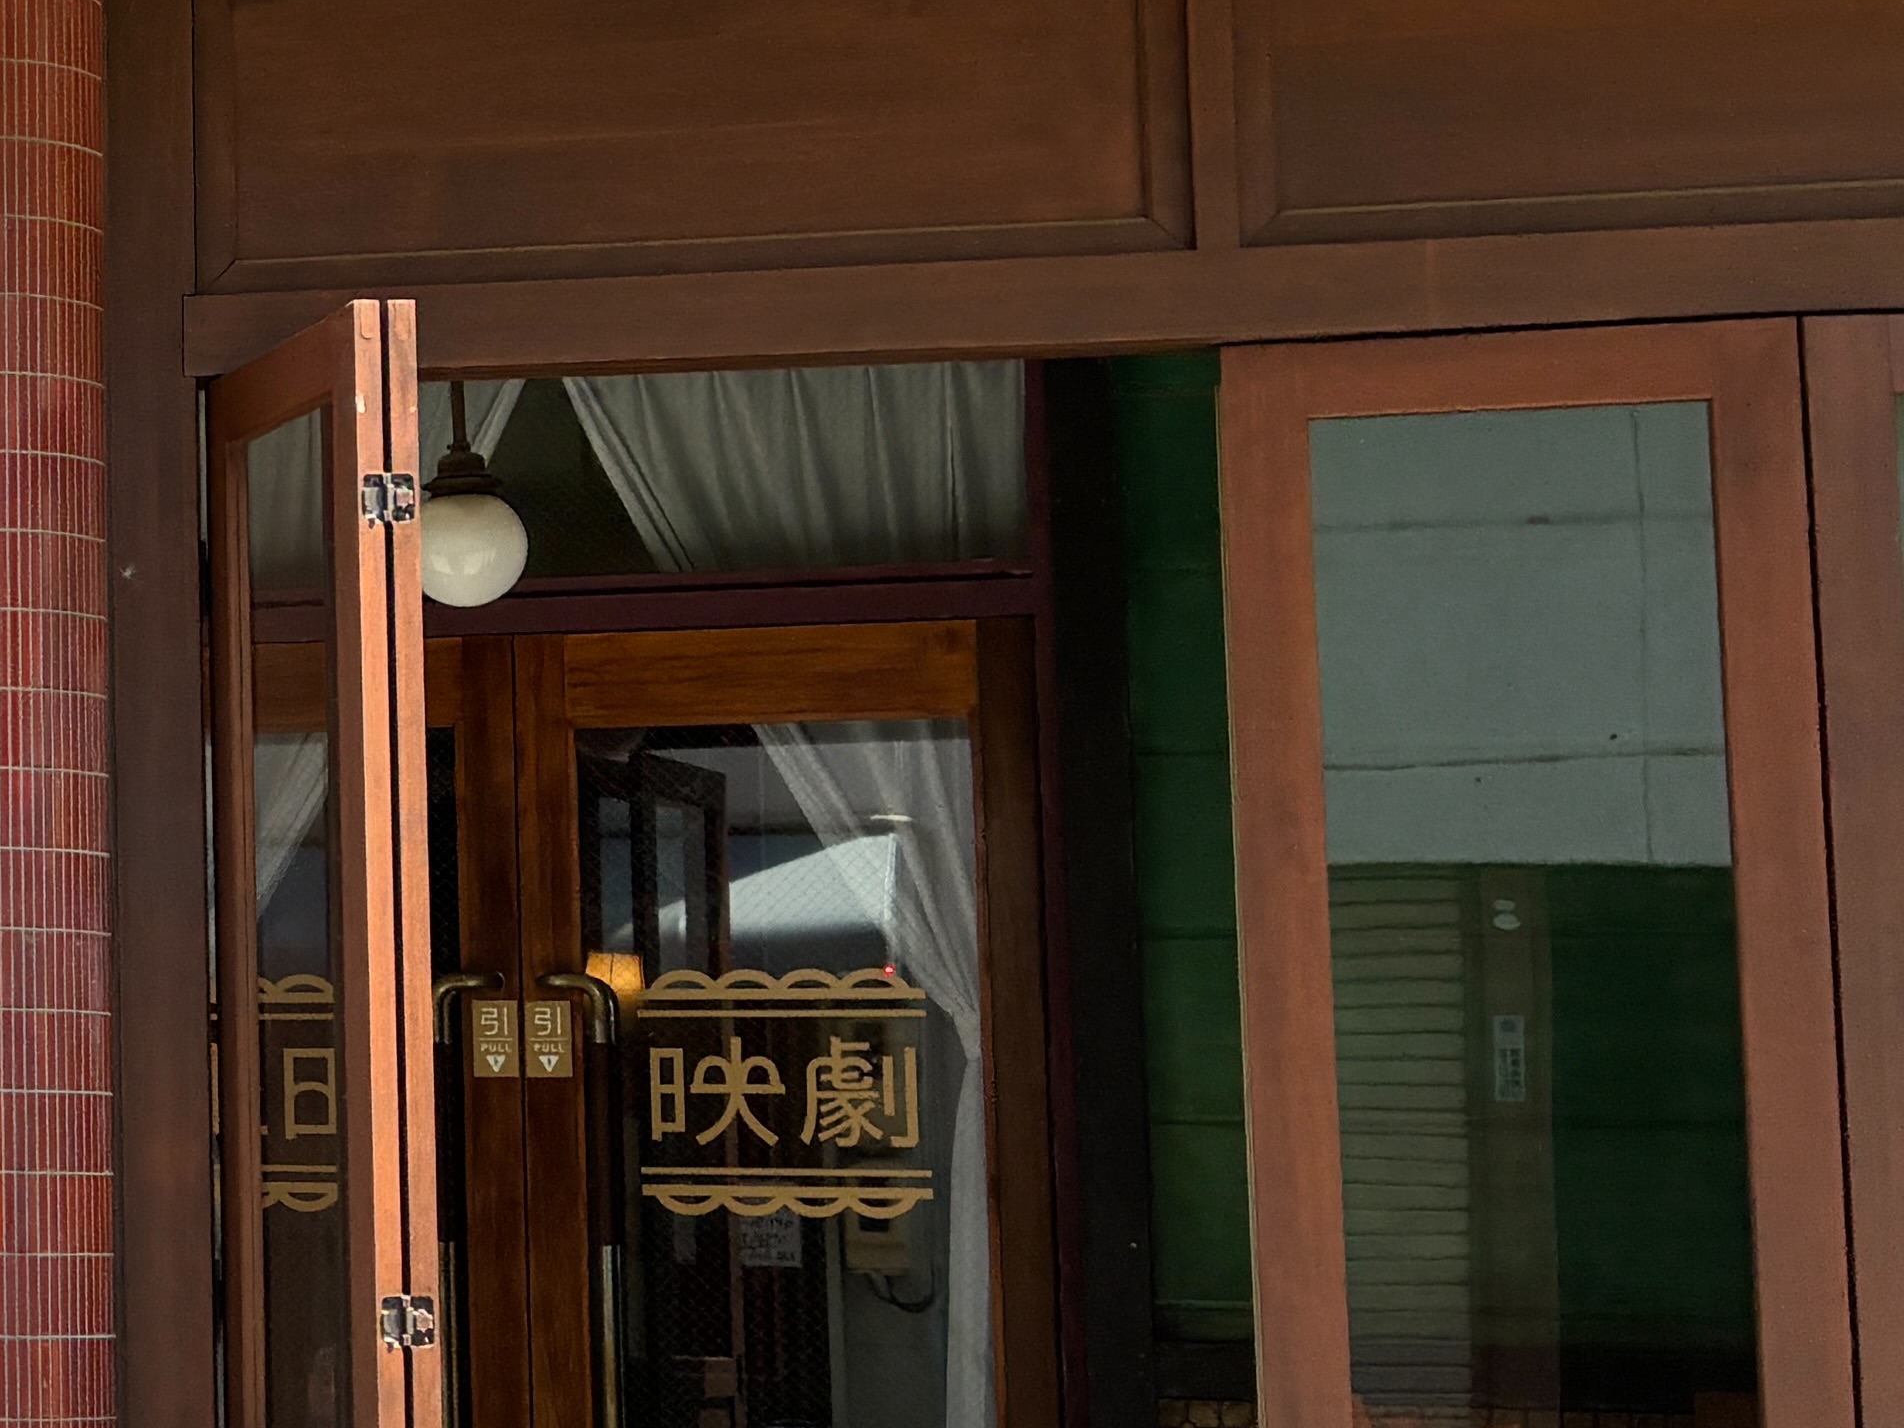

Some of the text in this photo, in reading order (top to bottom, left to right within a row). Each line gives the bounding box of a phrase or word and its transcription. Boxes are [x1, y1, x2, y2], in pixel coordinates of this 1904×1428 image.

[481, 1007, 509, 1036] 引
[533, 1007, 562, 1036] 引
[480, 1042, 512, 1053] PULL
[533, 1042, 565, 1053] PULL
[649, 1036, 919, 1149] 映劇
